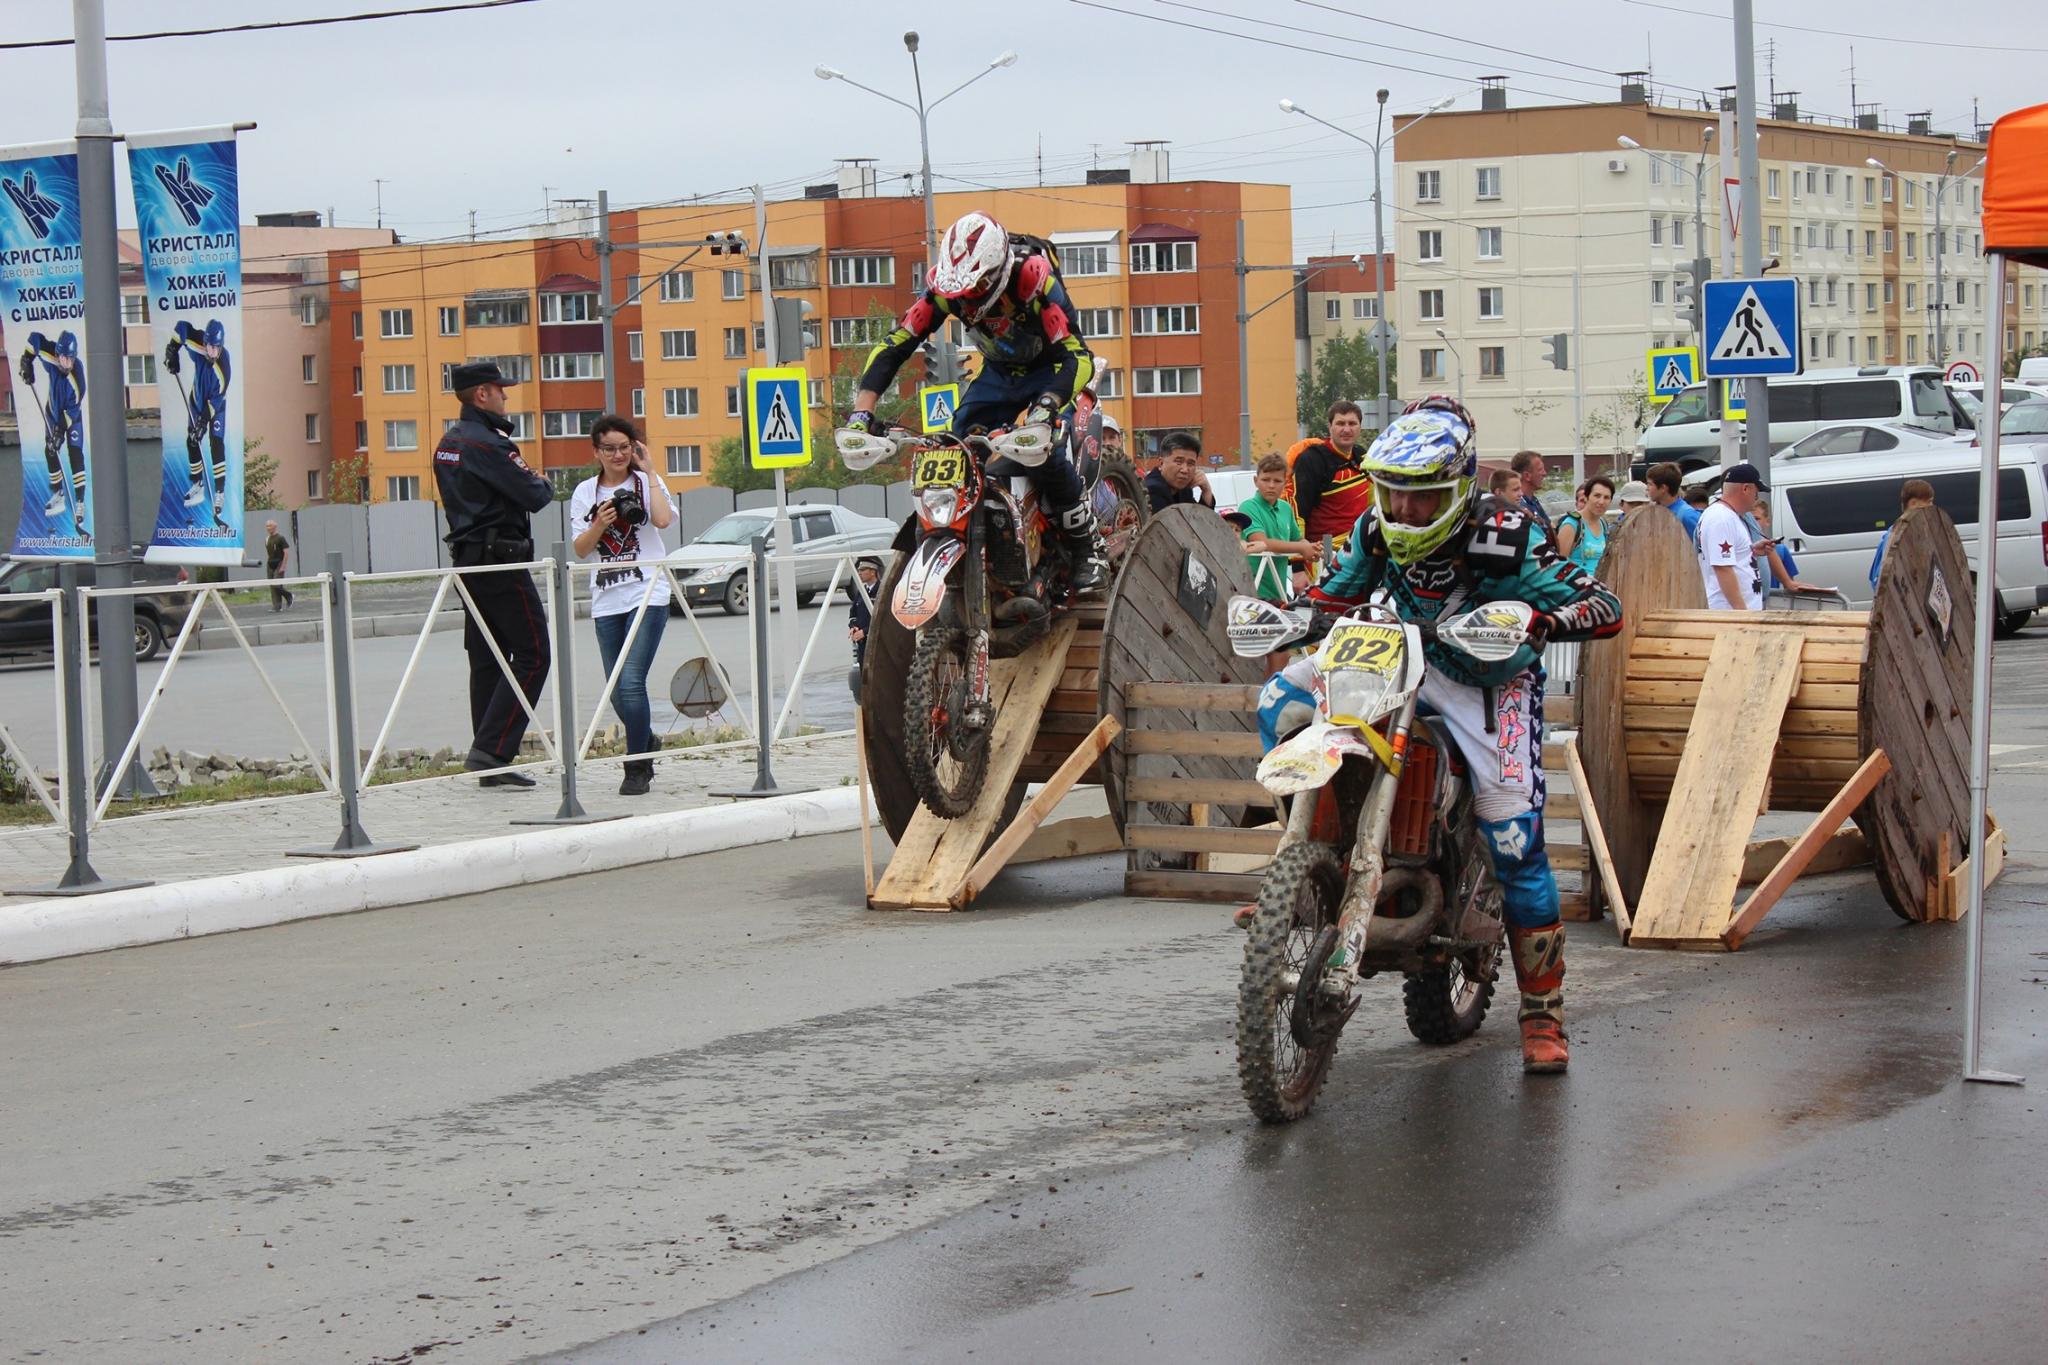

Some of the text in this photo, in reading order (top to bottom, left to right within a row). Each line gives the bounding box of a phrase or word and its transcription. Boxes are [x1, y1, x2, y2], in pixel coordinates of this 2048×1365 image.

[148, 233, 235, 254] КРИСТАЛЛ
[0, 245, 83, 266] КРИСТАЛЛ
[151, 251, 237, 267] дворец спорта
[2, 264, 82, 279] дворец спорт
[167, 270, 227, 291] ХОККЕЙ
[18, 282, 77, 303] ХОККЕЙ
[158, 289, 236, 311] С ШАЙБОЙ
[11, 301, 85, 322] С ШАЙБОЙ
[1953, 371, 1971, 383] 50
[921, 459, 957, 482] 83
[20, 535, 94, 548] www.ikristall.r
[157, 526, 238, 539] www.ikristall.ru
[1345, 625, 1402, 641] SAKHALIN
[1479, 631, 1511, 640] CYCRA
[1333, 637, 1391, 665] 82
